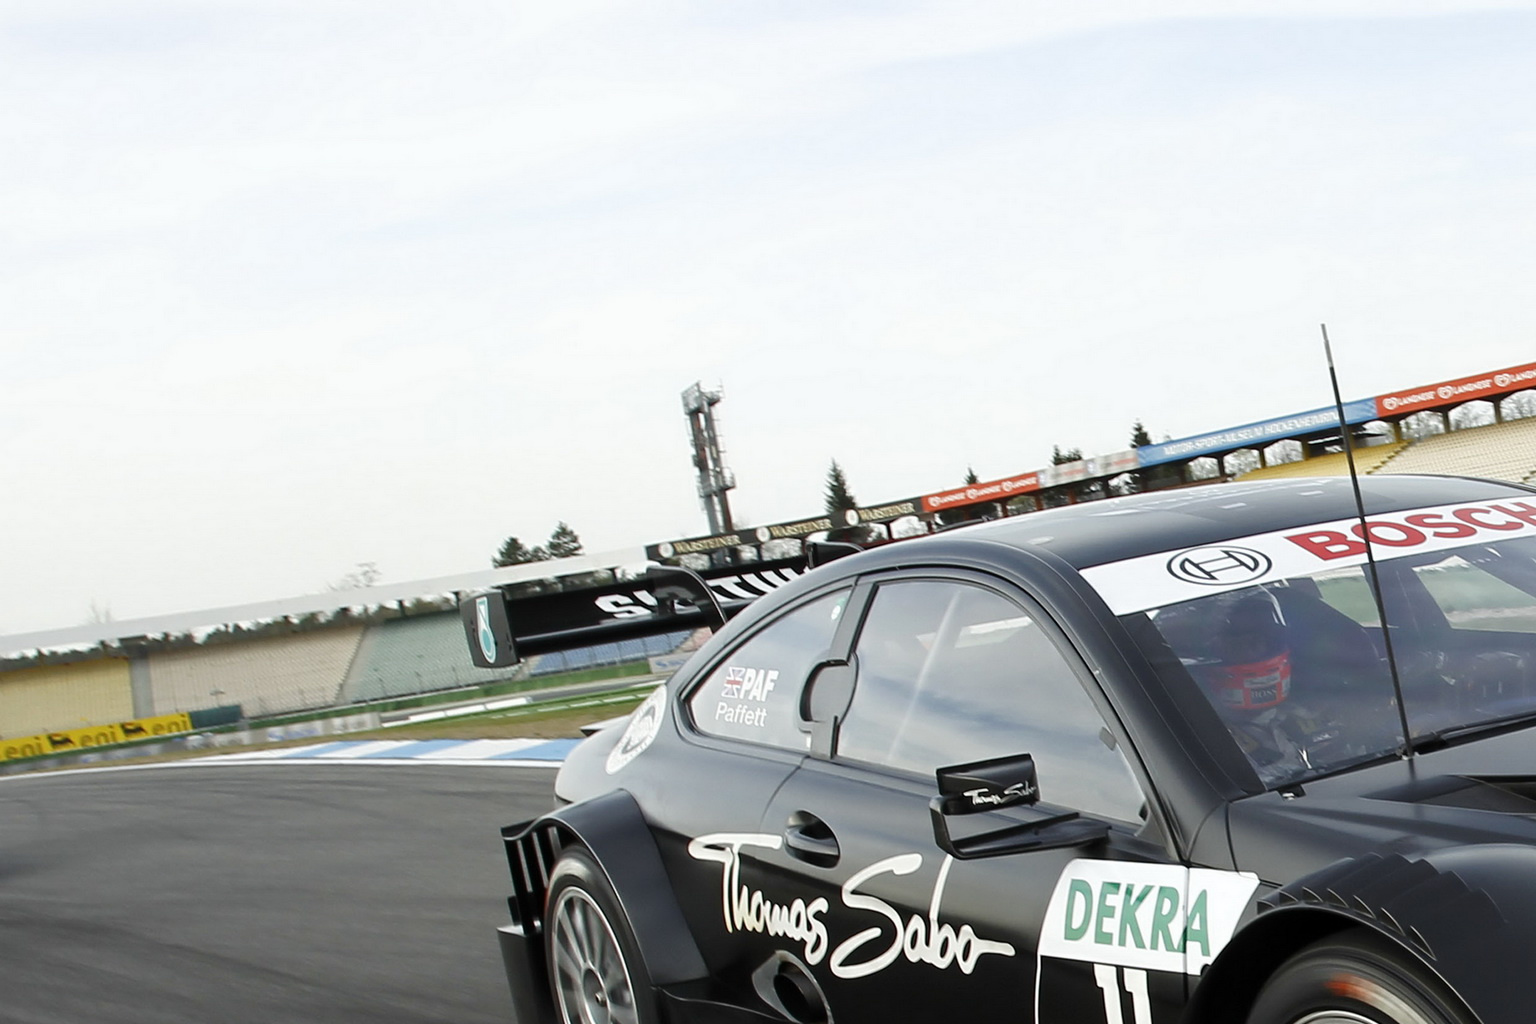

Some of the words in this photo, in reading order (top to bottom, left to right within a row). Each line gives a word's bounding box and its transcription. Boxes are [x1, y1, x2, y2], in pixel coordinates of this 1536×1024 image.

[858, 502, 915, 520] WARSTEINER
[769, 518, 833, 537] WARSTEINER
[673, 534, 741, 553] WARSTEINER
[740, 668, 779, 702] PAF
[151, 714, 189, 736] eni
[715, 702, 767, 727] Paffett
[80, 725, 118, 747] eni
[5, 737, 43, 759] eni
[688, 833, 829, 966] Thomas
[830, 853, 1016, 980] Sabo
[1064, 879, 1211, 957] DEKRA
